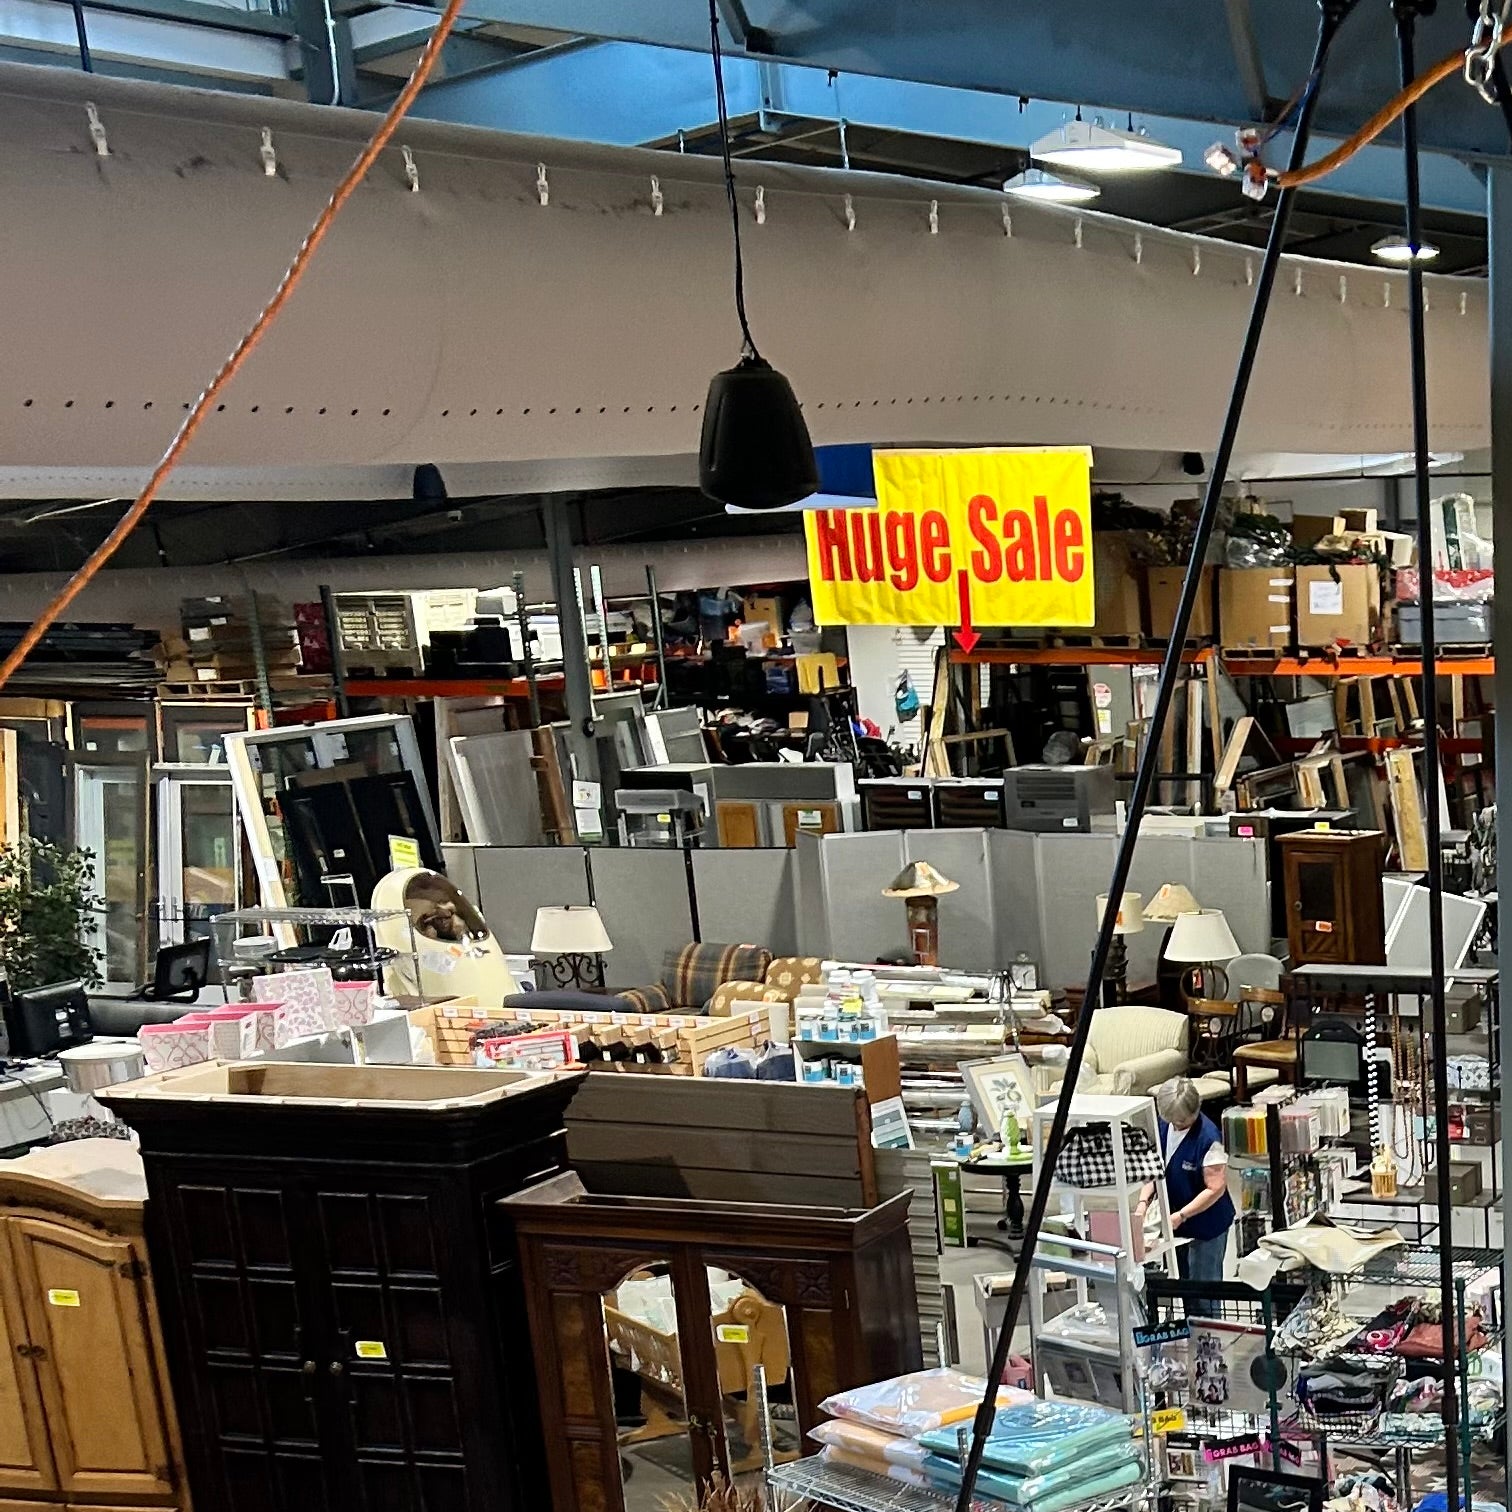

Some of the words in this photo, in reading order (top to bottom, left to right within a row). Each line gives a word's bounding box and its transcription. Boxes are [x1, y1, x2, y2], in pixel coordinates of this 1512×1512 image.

[816, 509, 951, 591] Huge
[968, 494, 1084, 583] Sale
[1143, 1331, 1168, 1343] GRAB
[1169, 1327, 1190, 1338] BAG
[1212, 1444, 1239, 1458] GRAB
[1239, 1441, 1259, 1453] BAG
